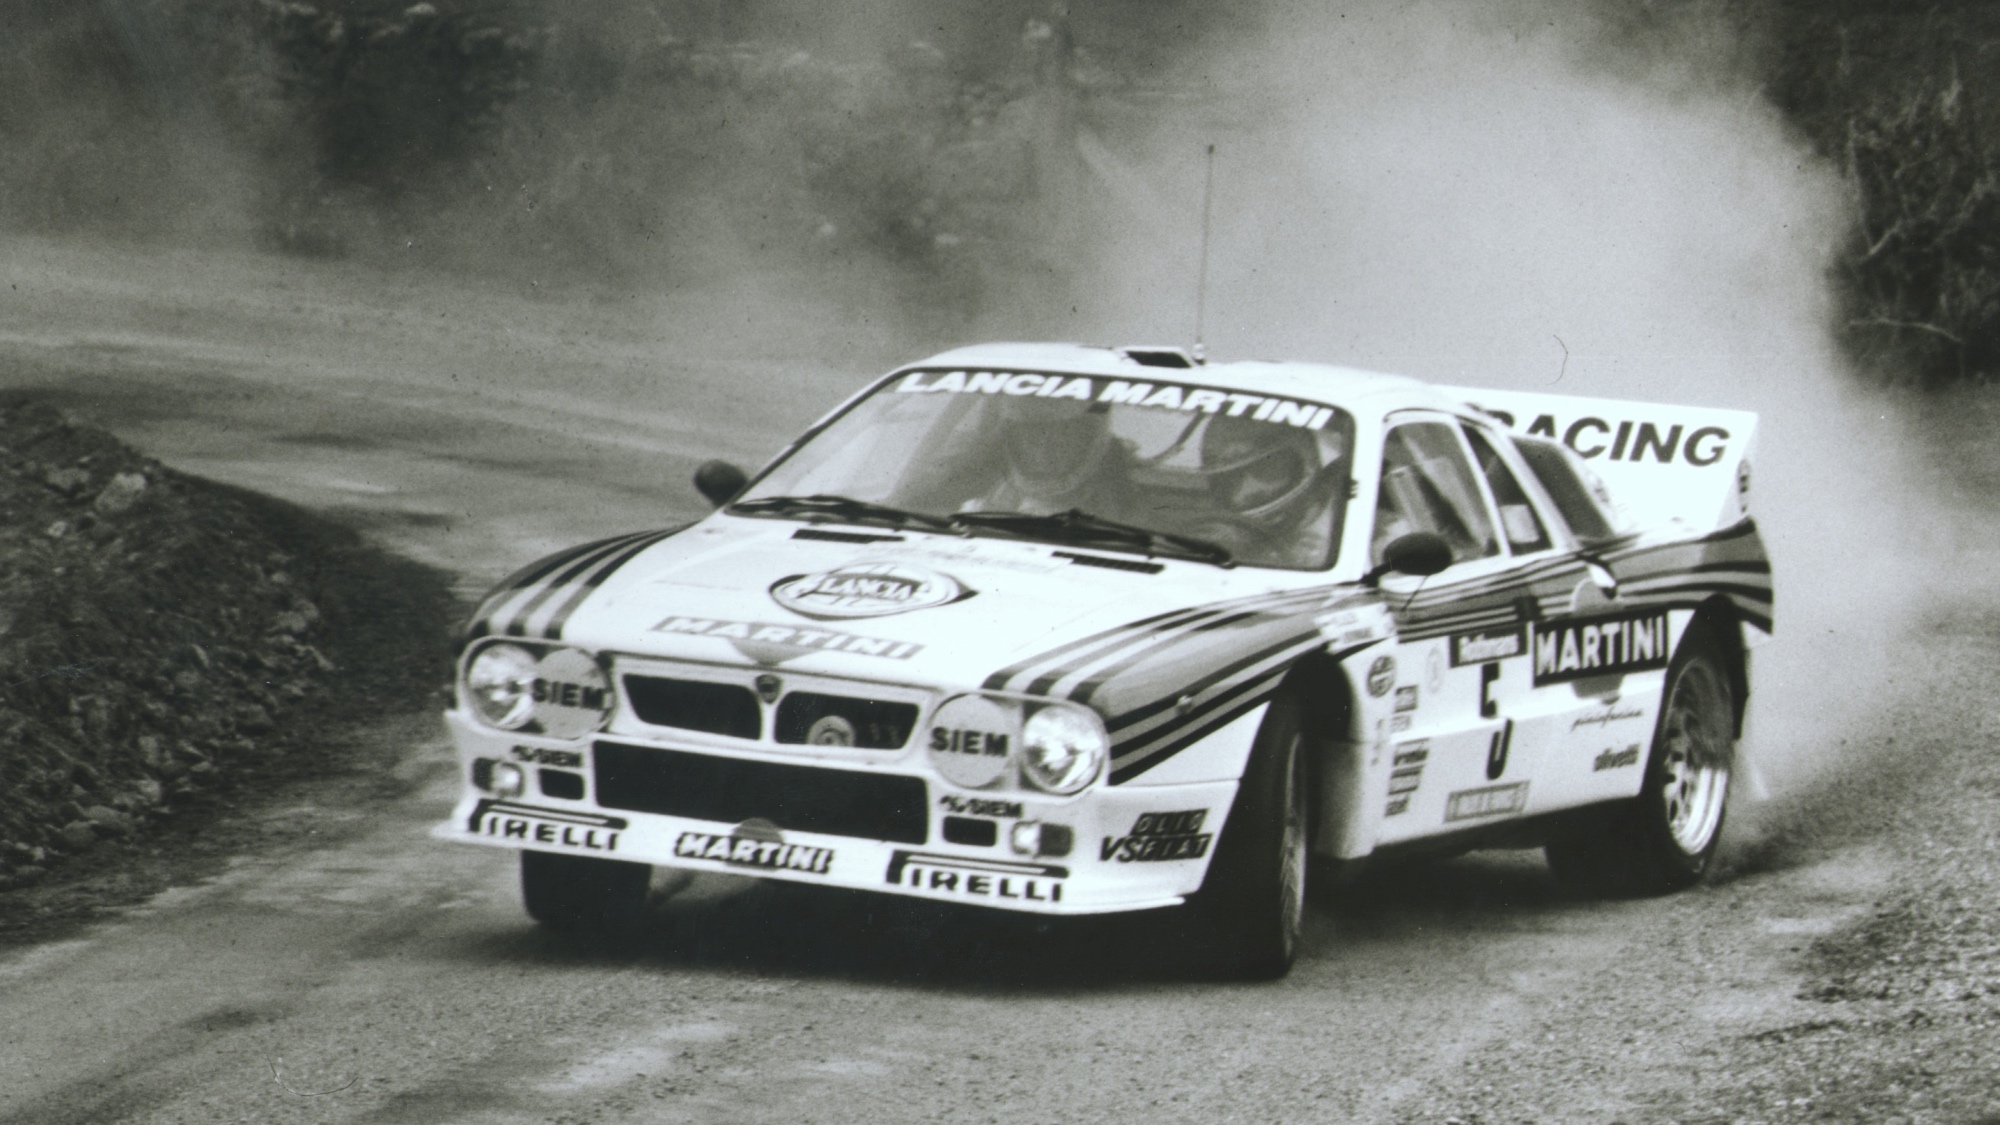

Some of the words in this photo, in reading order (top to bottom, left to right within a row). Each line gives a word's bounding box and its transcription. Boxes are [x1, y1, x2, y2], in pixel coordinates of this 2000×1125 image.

[894, 372, 1094, 400] LANCIA
[1097, 379, 1334, 430] MARTINI
[648, 616, 926, 660] MARTINI
[1535, 616, 1667, 676] MARTINI
[532, 678, 604, 709] SIEM
[930, 725, 1010, 757] SIEM
[467, 798, 628, 850] PIRELLI
[675, 832, 832, 874] MARTINI
[886, 849, 1070, 901] PIRELLI
